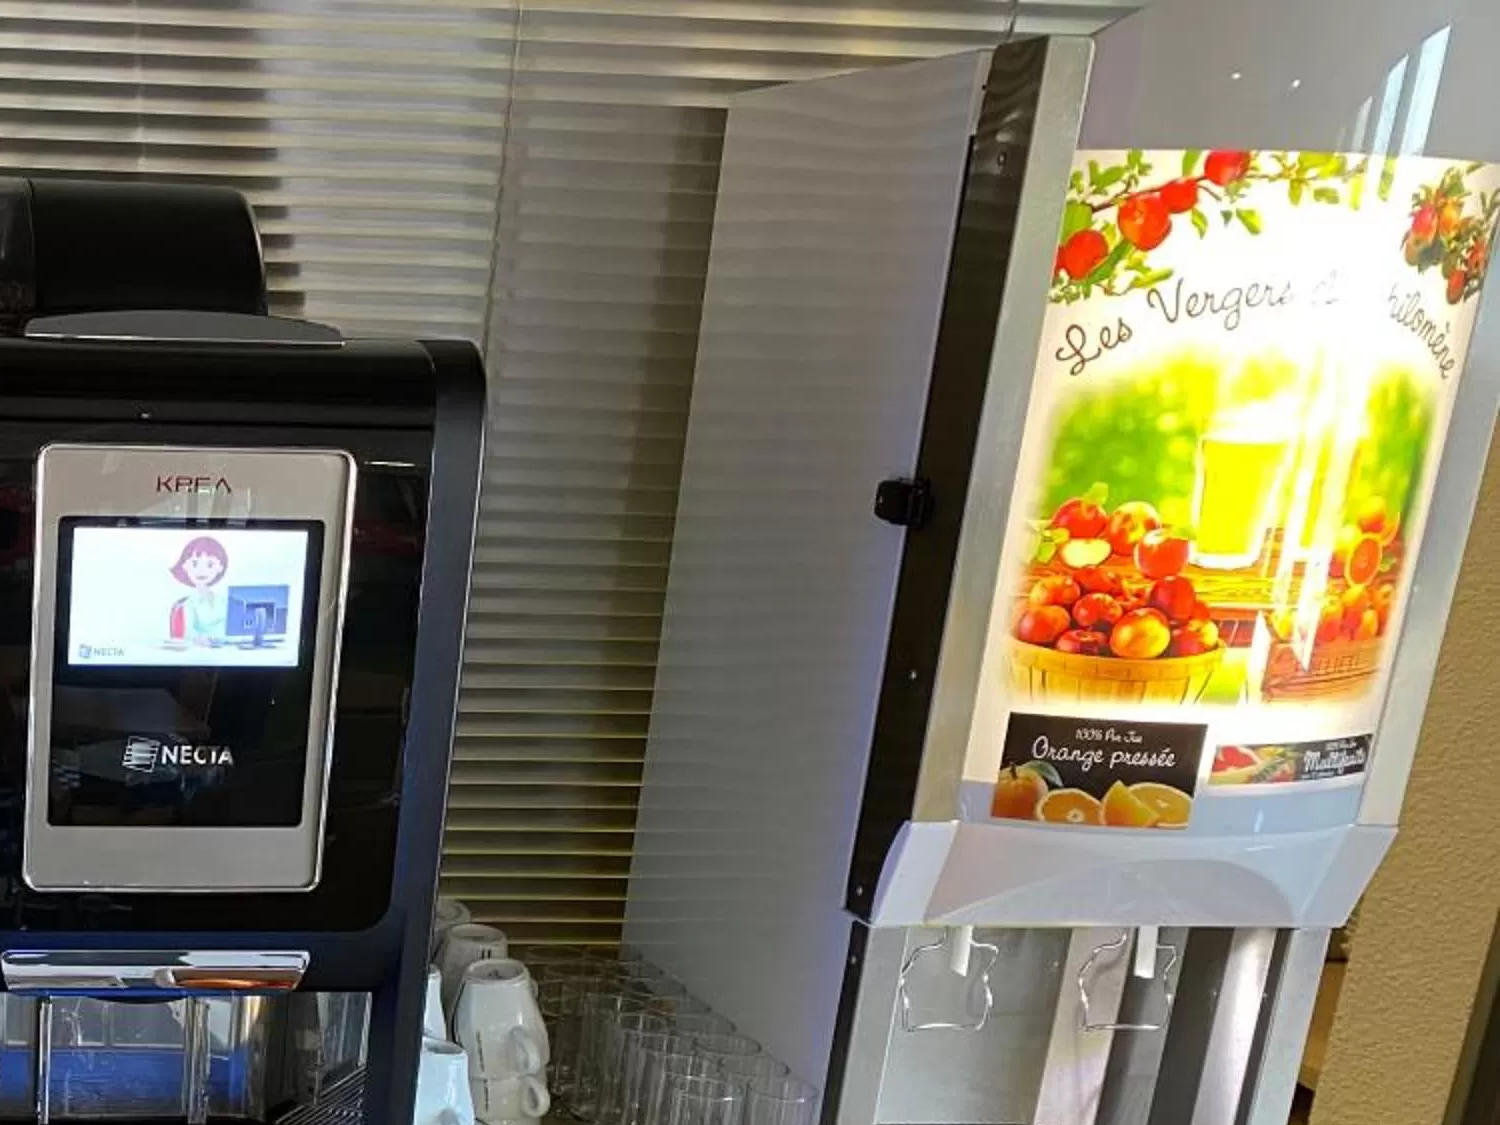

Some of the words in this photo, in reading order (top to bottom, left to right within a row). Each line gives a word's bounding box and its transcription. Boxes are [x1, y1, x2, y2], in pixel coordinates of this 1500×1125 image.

[1055, 317, 1133, 376] Les
[1388, 282, 1455, 380] hilomène
[161, 745, 234, 765] NECTA
[1032, 735, 1105, 772] Orange
[1109, 747, 1177, 769] pressée
